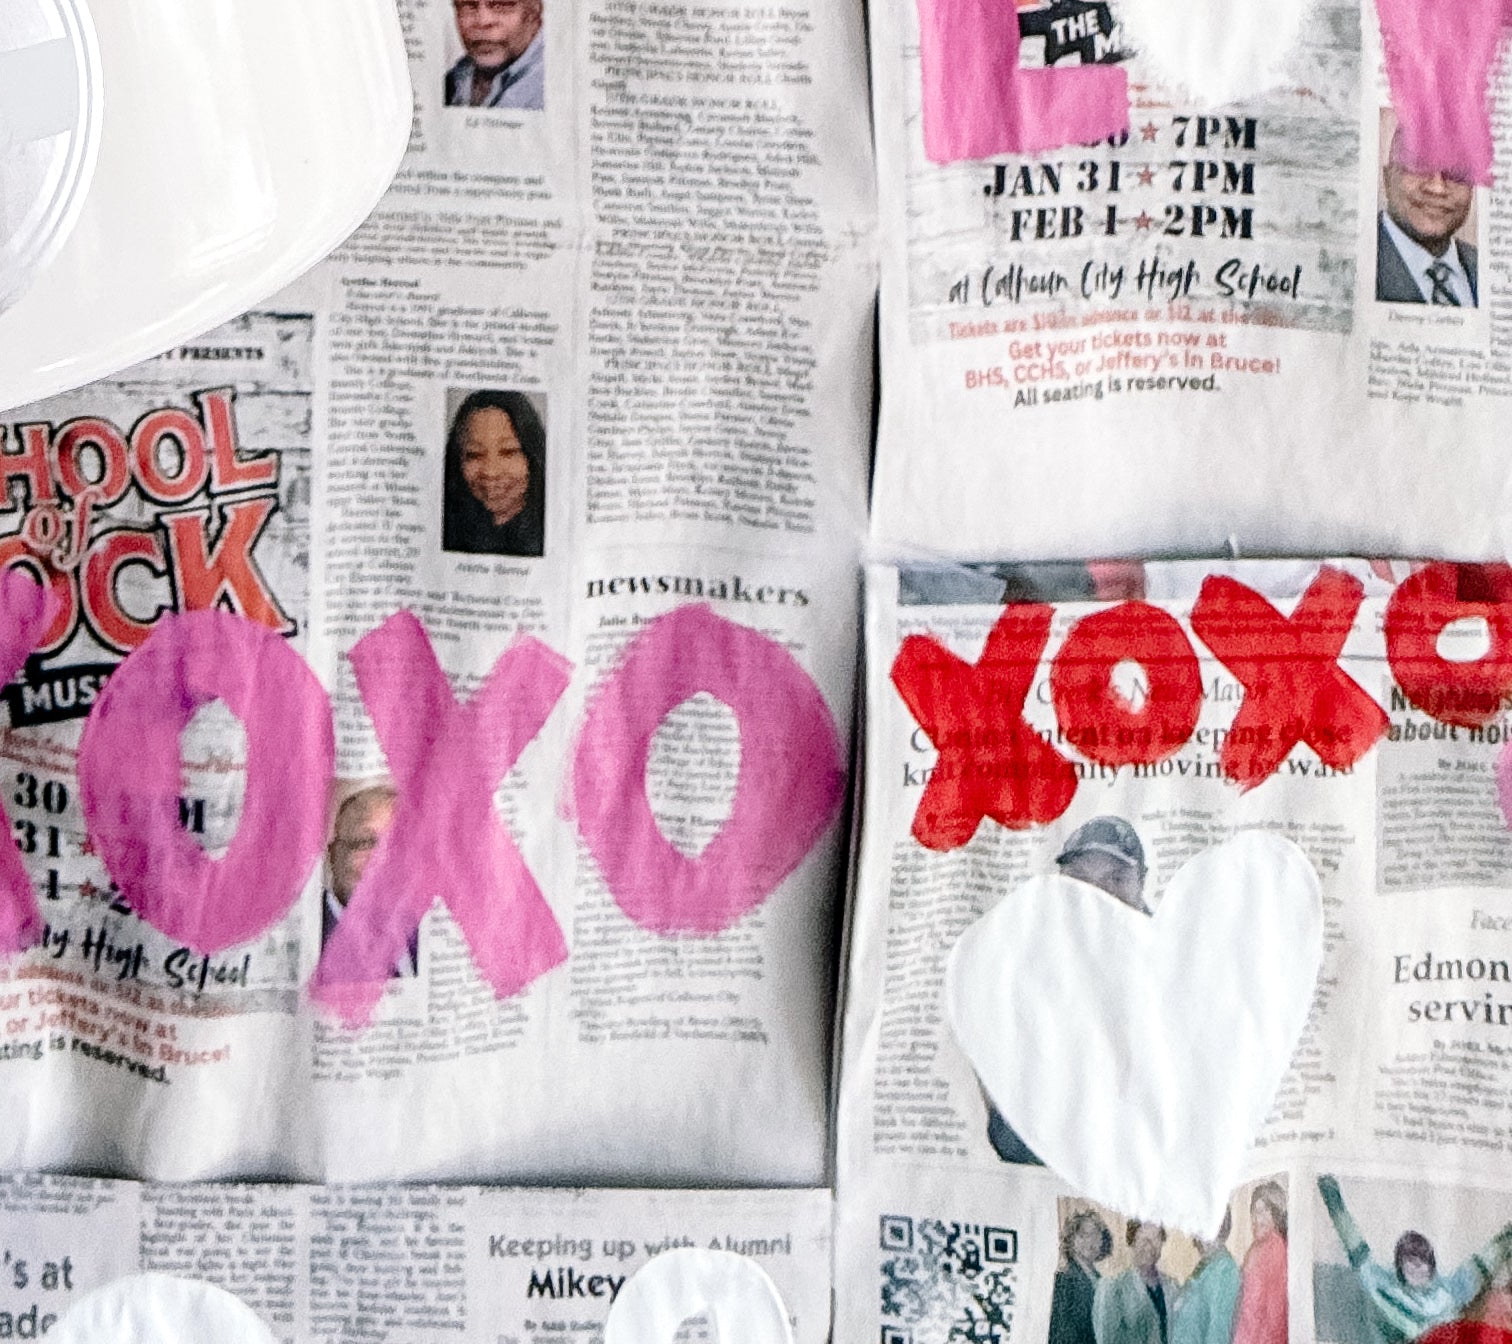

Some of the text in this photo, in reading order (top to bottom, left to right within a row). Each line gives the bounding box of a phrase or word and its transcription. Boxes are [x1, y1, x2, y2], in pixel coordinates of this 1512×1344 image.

[1050, 9, 1100, 44] THE
[1171, 115, 1259, 151] 7PM
[983, 160, 1257, 198] JAN 31 7PM
[1008, 204, 1256, 242] FEB 1 2PM
[948, 256, 1304, 306] at Calhoun City High School
[179, 345, 265, 364] PRESENTS
[1008, 329, 1229, 363] Get your tickets now at
[964, 348, 1283, 391] BHS, CCHS, or Jeffery's Bruce!
[1014, 373, 1223, 410] All seating is reserved.
[21, 485, 104, 574] of
[585, 574, 810, 608] newsmakers
[13, 771, 69, 816] 30
[13, 818, 62, 860] 31
[164, 945, 251, 991] School
[49, 1032, 67, 1051] is
[488, 1232, 636, 1262] Keeping up
[40, 1255, 74, 1291] at
[526, 1266, 627, 1305] Mikey
